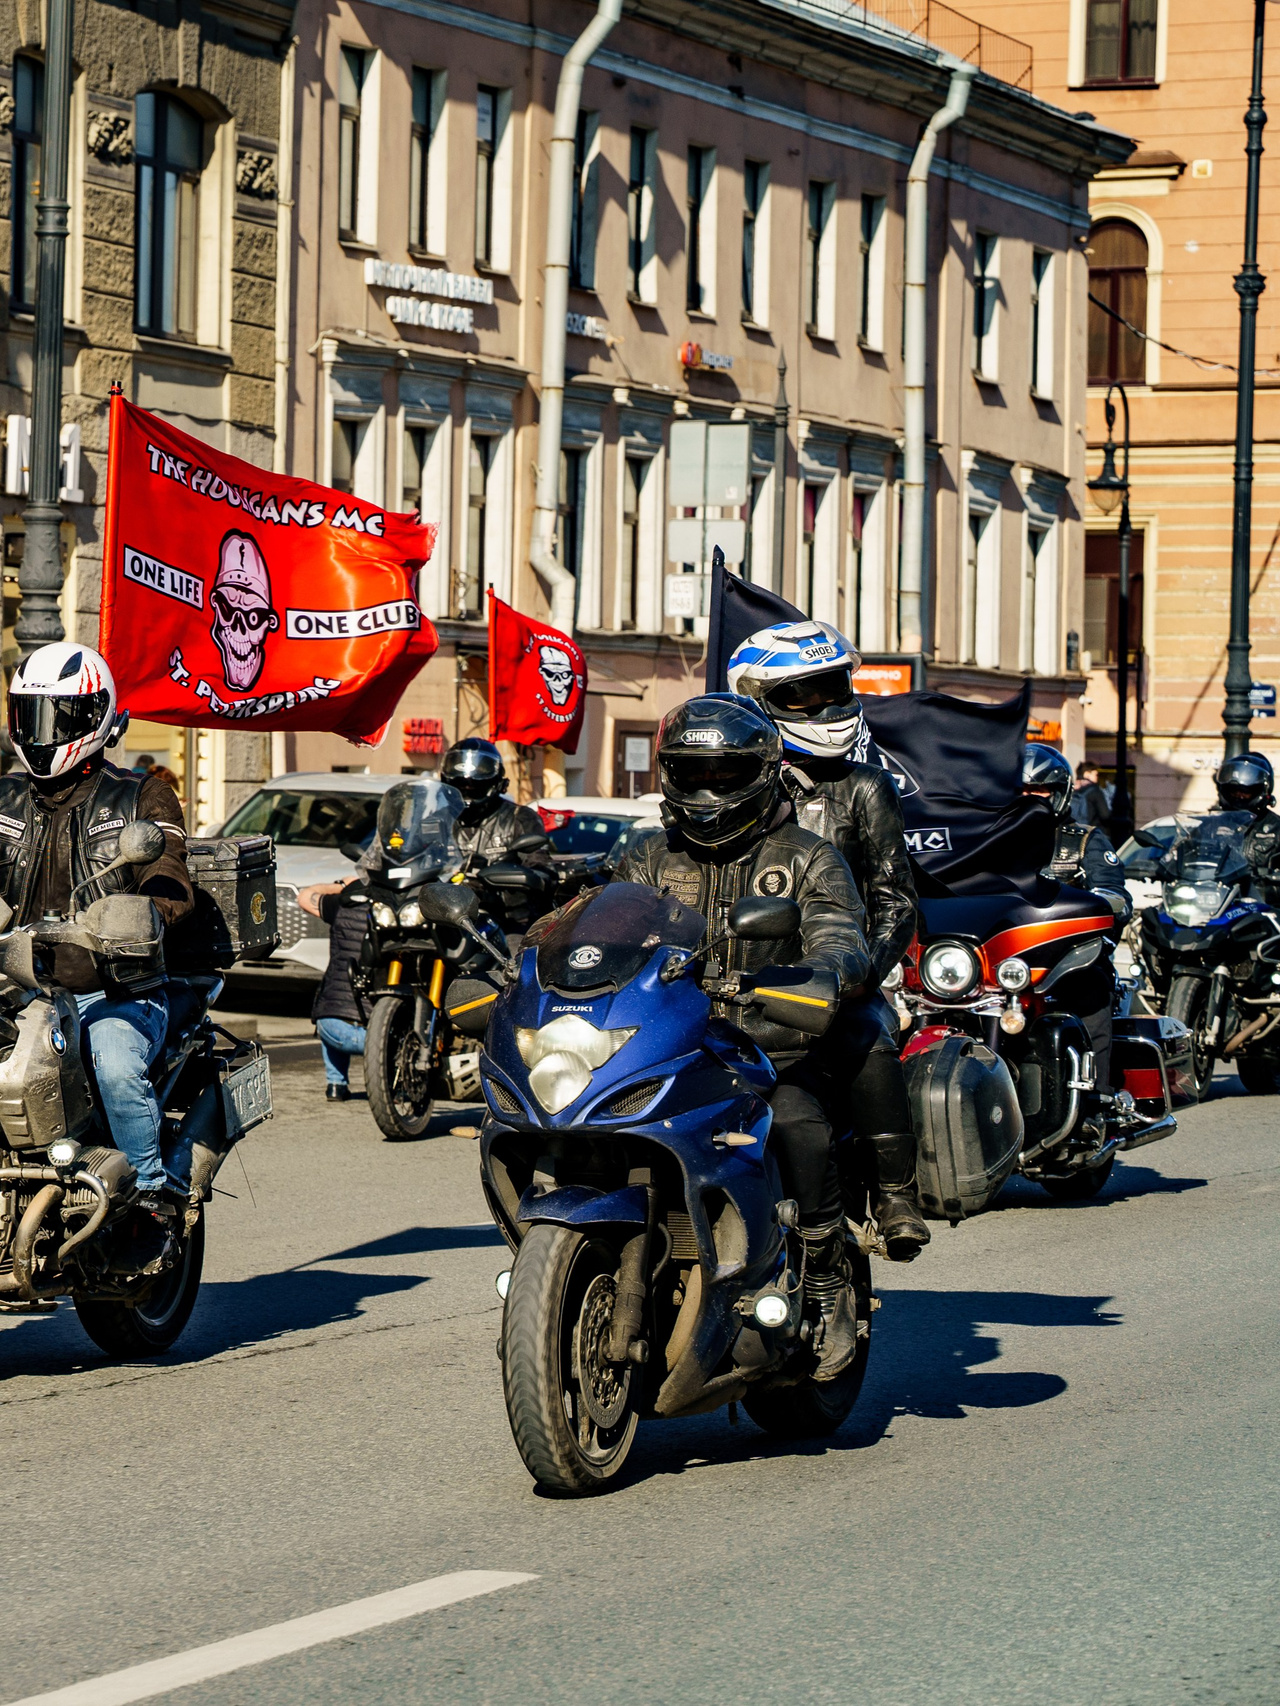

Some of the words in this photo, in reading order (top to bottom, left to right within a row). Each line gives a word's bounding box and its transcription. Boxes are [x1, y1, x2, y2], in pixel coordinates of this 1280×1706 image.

[147, 442, 191, 487] THE
[331, 504, 386, 537] MC
[130, 554, 165, 588] ONE
[170, 571, 201, 604] LIFE
[294, 615, 350, 635] ONE
[356, 601, 418, 631] CLUB
[804, 645, 834, 659] SHOEI
[685, 731, 718, 743] SHOEI
[90, 820, 122, 833] MEMBER
[903, 831, 945, 851] MC
